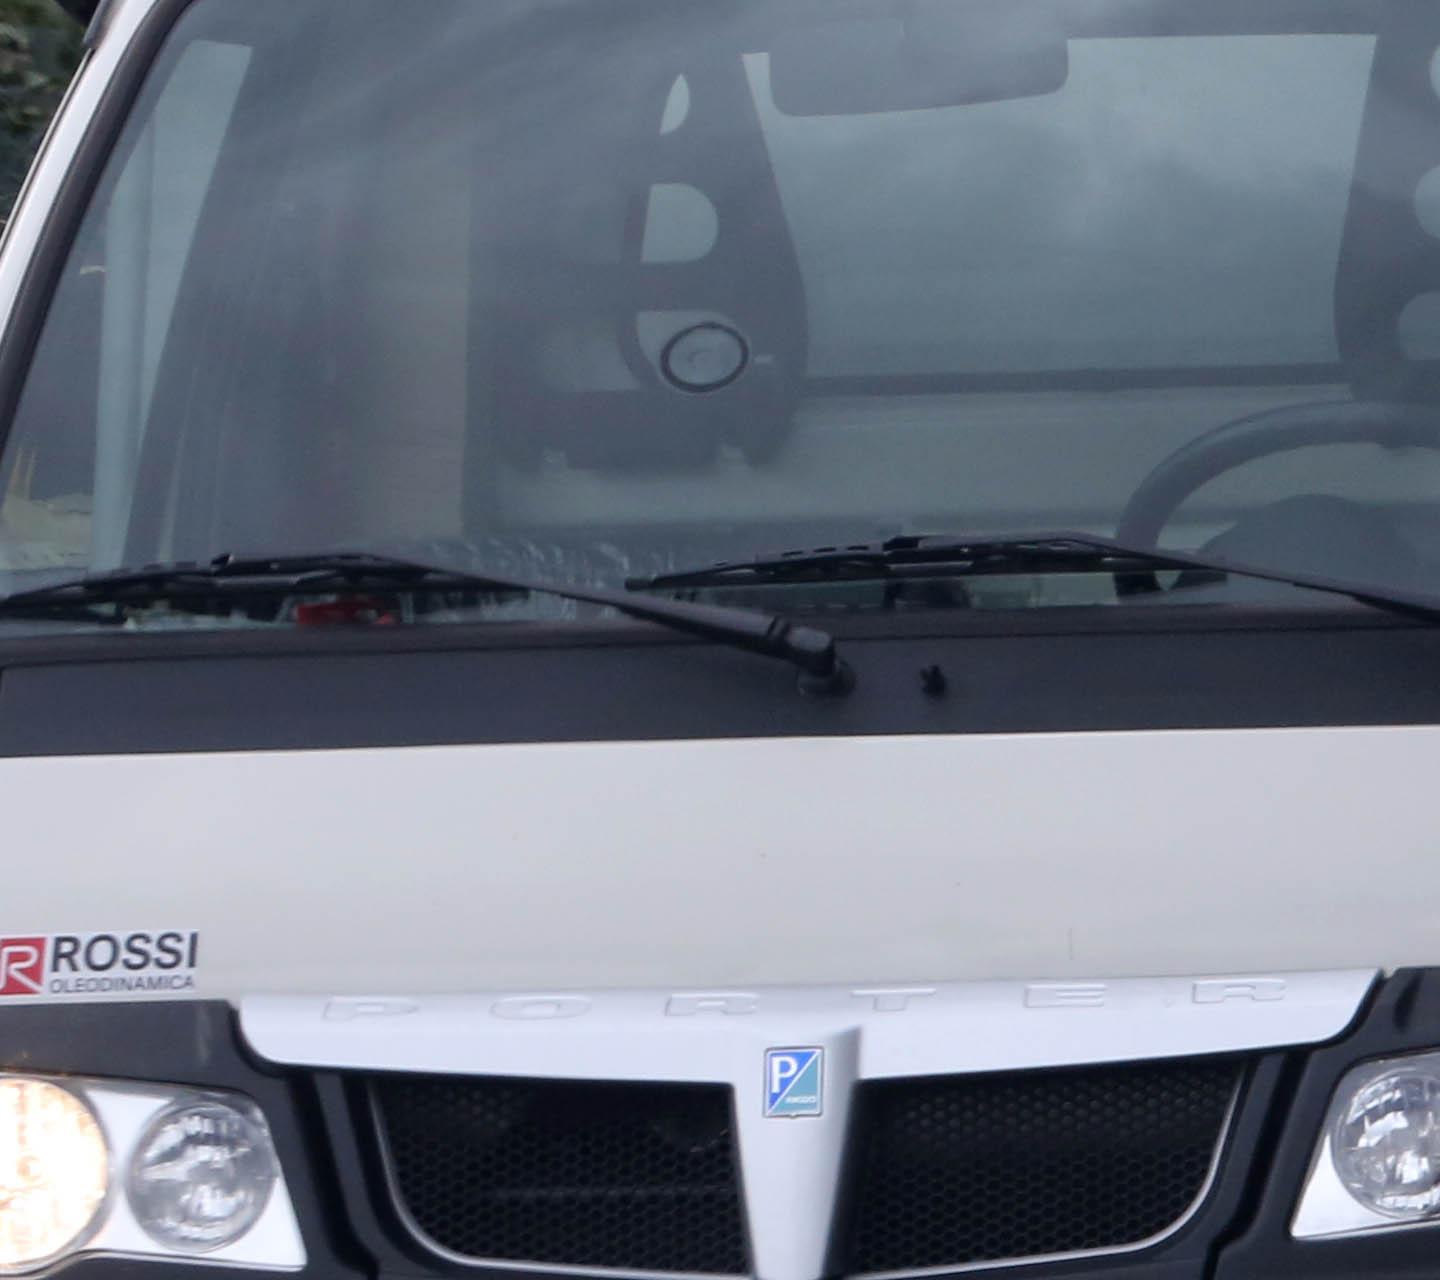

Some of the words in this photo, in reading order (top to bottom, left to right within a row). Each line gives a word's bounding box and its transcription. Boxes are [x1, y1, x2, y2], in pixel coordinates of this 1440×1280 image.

[51, 932, 199, 972] ROSSI
[50, 975, 195, 994] OLEODINAMICA
[324, 979, 1288, 1021] PORTER
[770, 1054, 799, 1094] P
